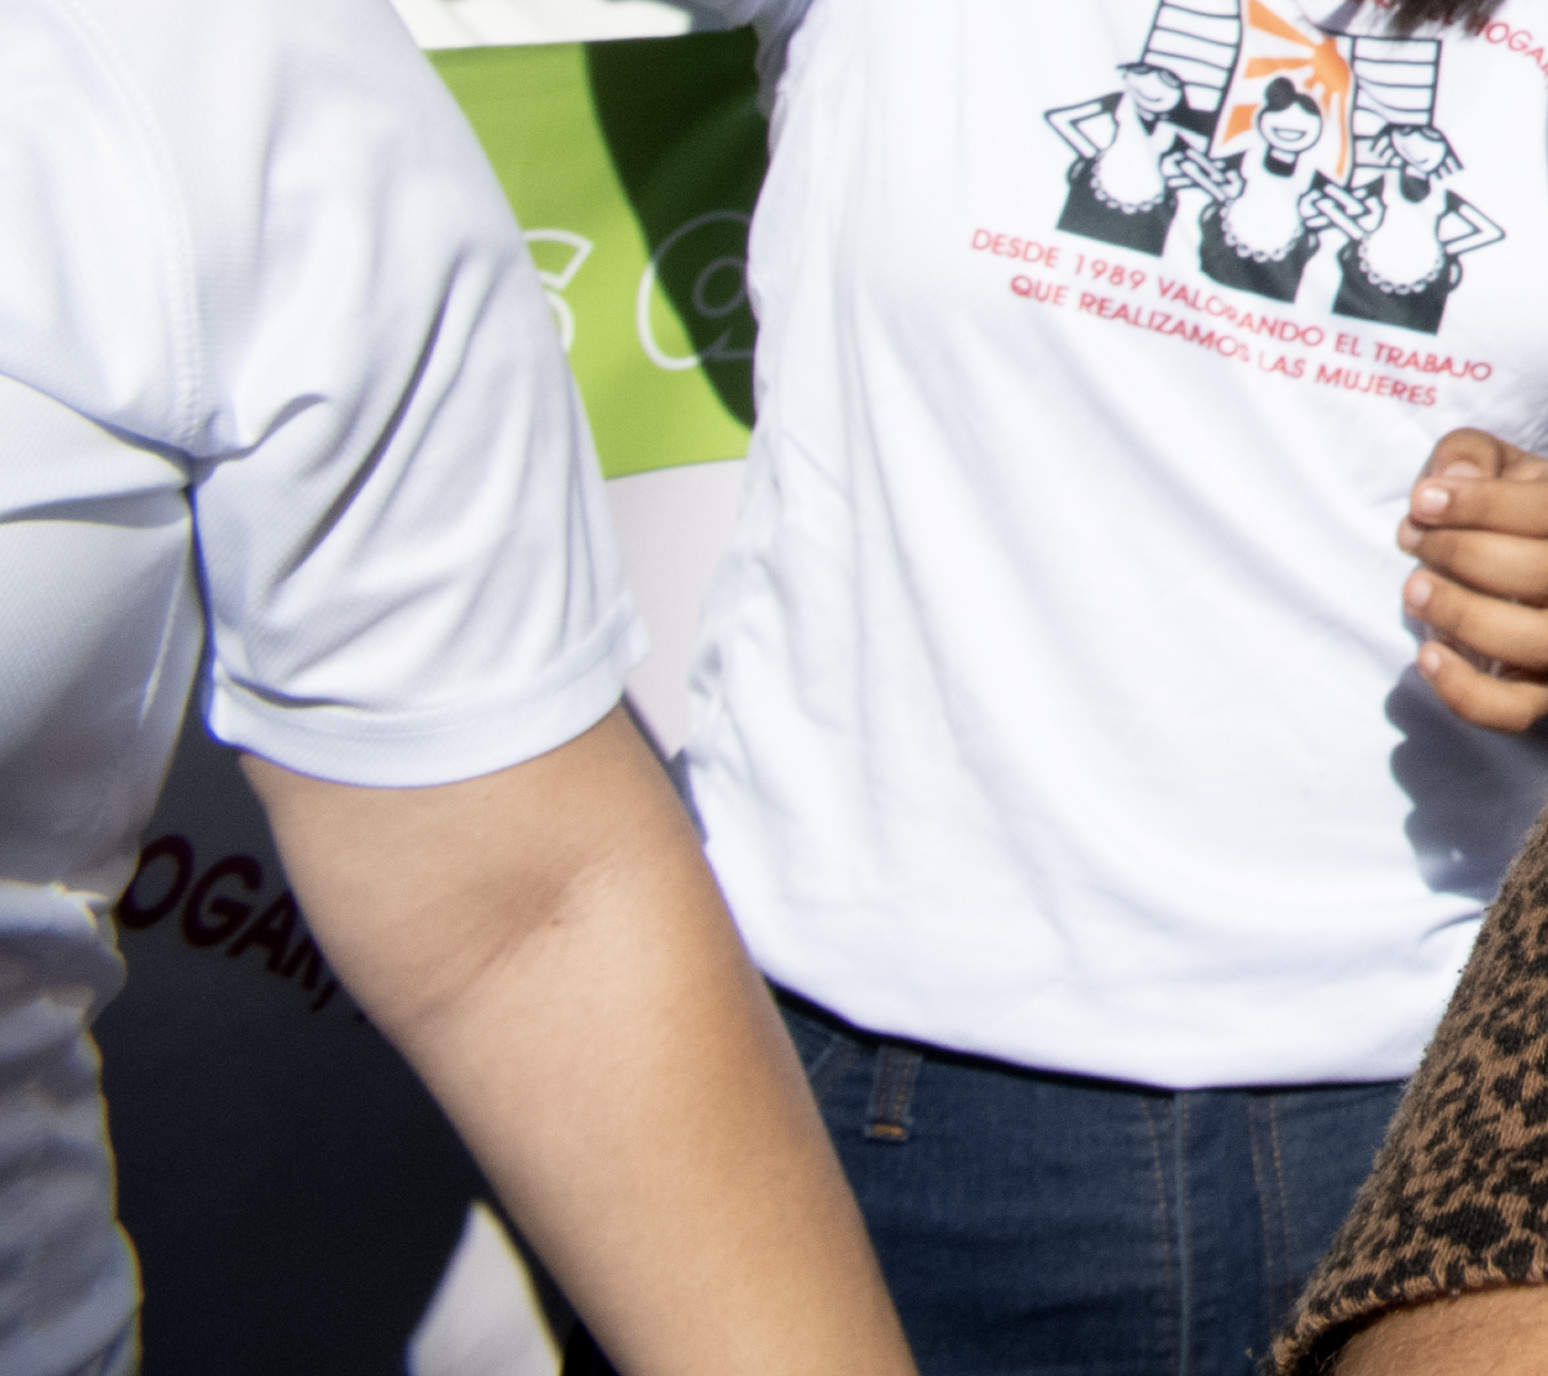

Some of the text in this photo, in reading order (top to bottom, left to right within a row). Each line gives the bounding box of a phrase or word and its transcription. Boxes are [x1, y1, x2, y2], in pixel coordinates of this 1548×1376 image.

[971, 228, 1492, 383] DESDE 1989 VALORANDO EL TRABAJO
[1010, 275, 1438, 408] QUE REALIZAMOS LAS MUJERES
